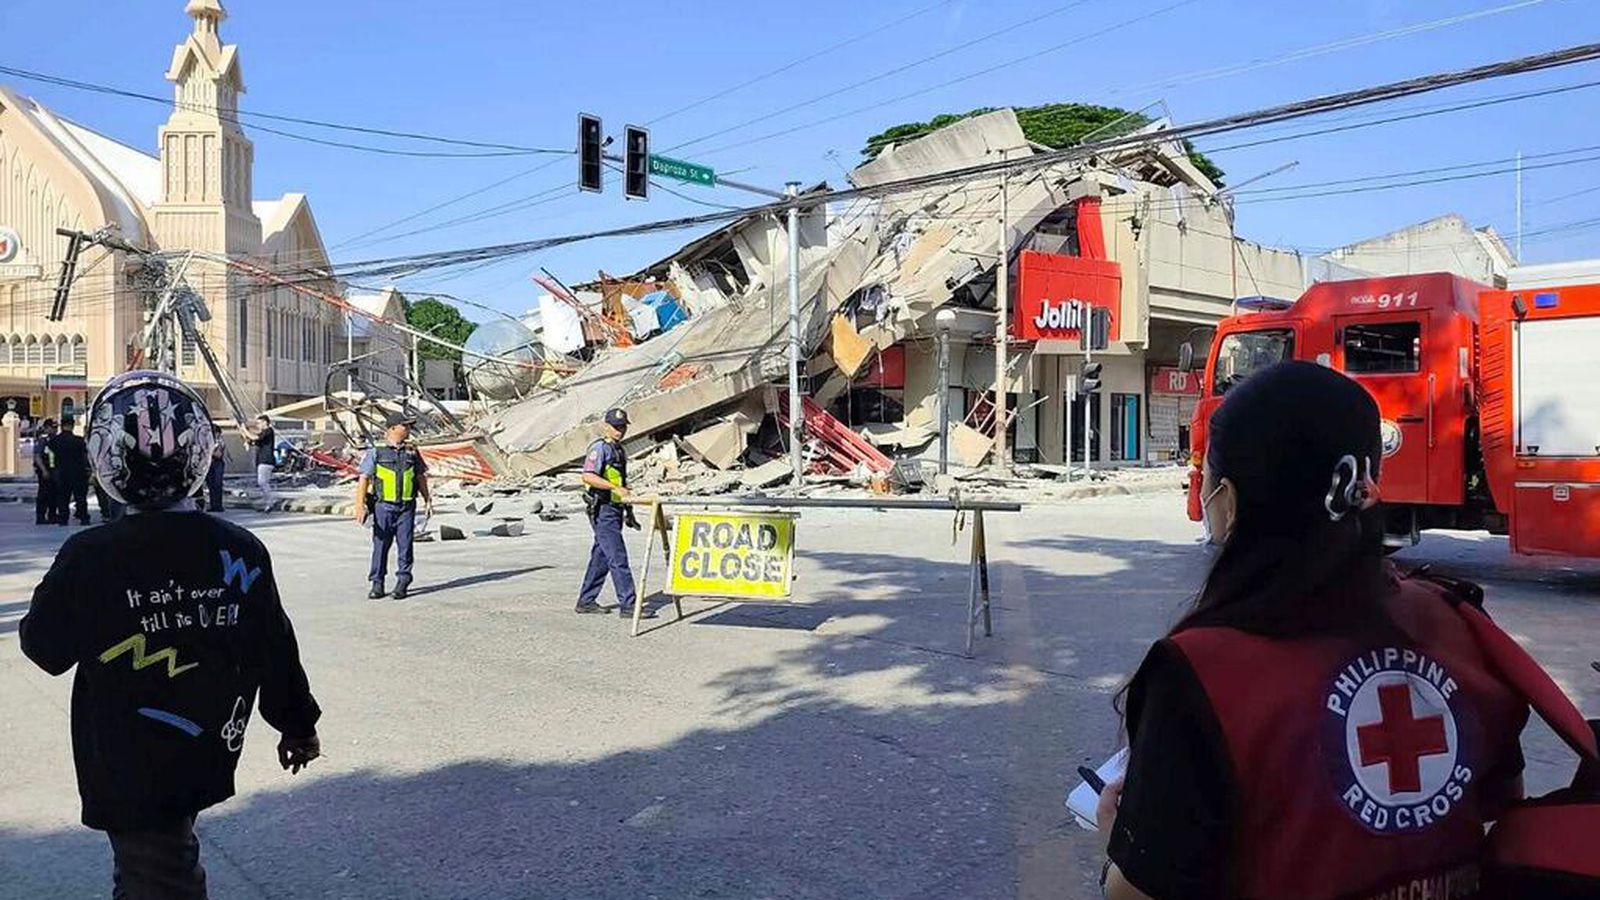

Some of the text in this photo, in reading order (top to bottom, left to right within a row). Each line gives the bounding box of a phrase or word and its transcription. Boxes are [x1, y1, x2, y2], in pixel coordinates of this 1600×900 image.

[1033, 298, 1111, 329] Jolli
[1377, 291, 1418, 308] 911
[692, 522, 778, 550] ROAD
[681, 551, 783, 582] CLOSE
[126, 580, 225, 608] It ain't over
[141, 611, 169, 632] till
[1327, 648, 1458, 717] PHILIPPINE
[1342, 764, 1472, 829] RED CROSS
